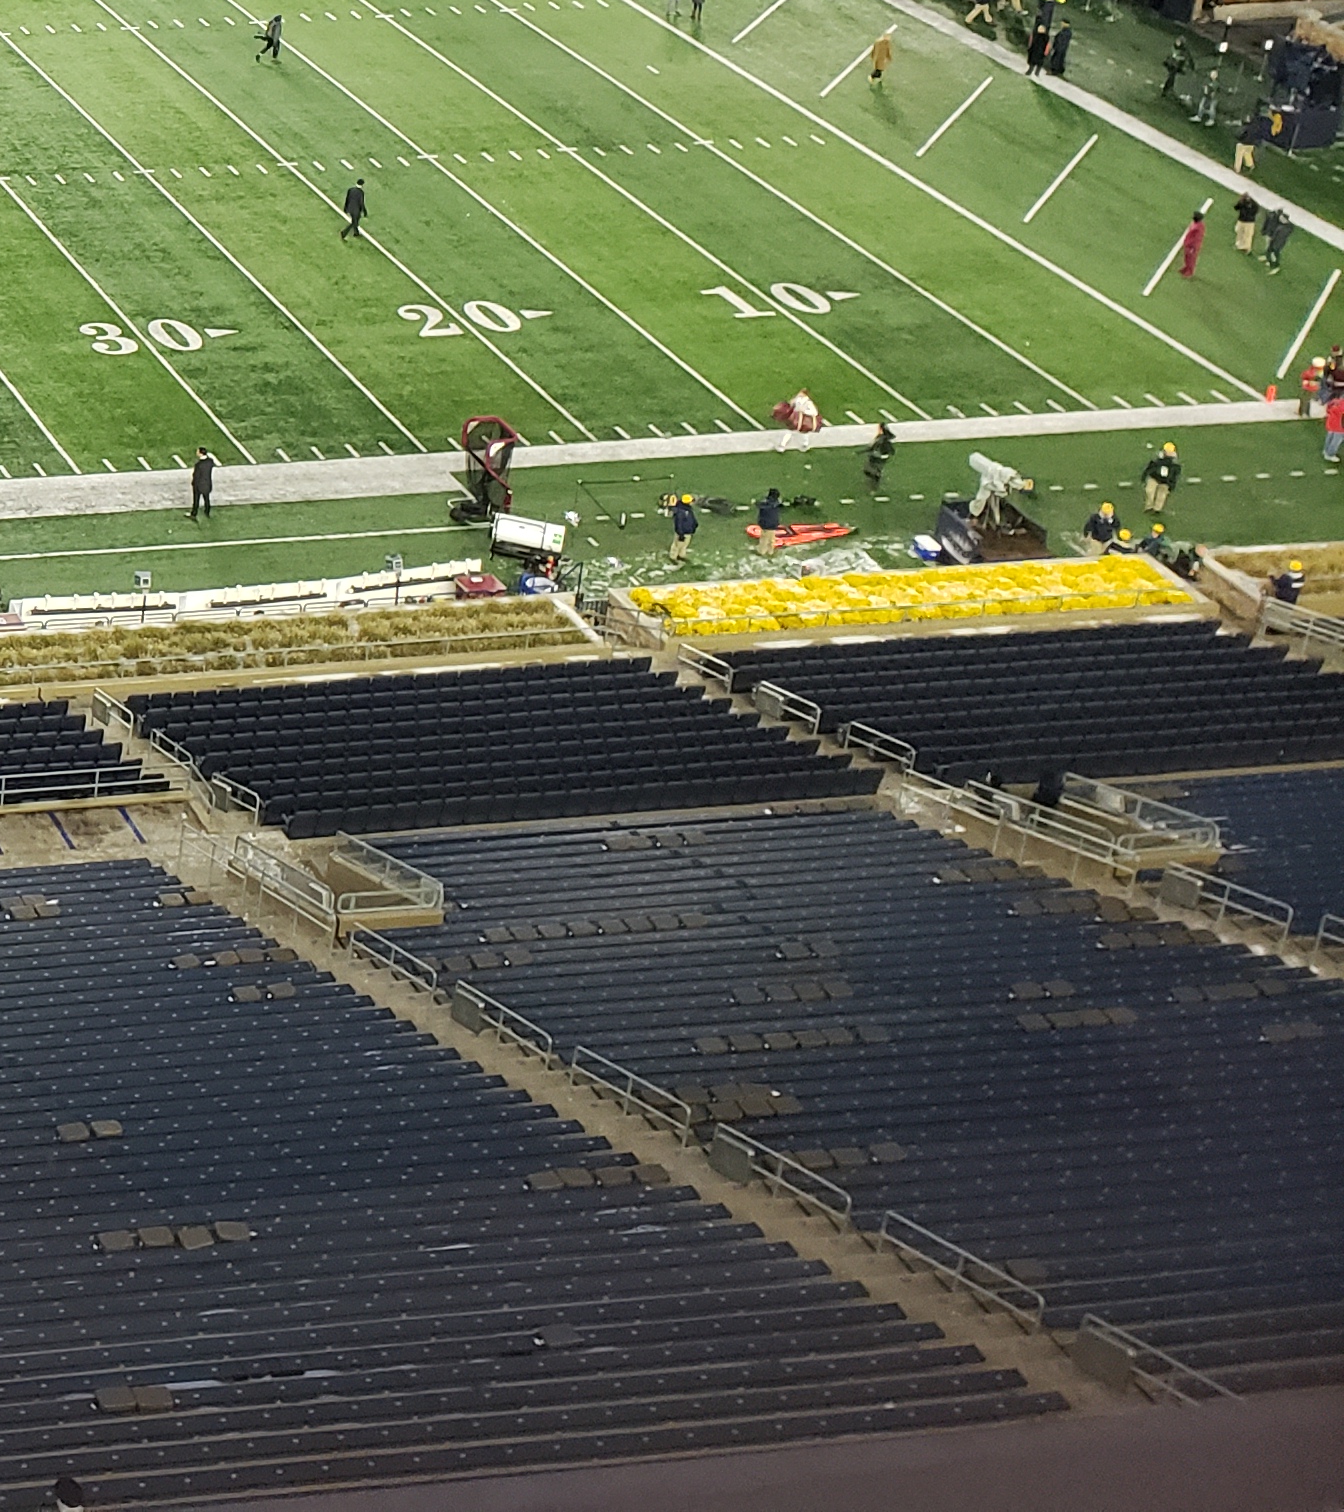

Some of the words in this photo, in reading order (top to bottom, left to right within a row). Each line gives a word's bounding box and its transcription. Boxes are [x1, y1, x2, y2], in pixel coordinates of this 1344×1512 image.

[397, 299, 521, 338] 20
[701, 282, 832, 319] 10
[78, 318, 204, 354] 30
